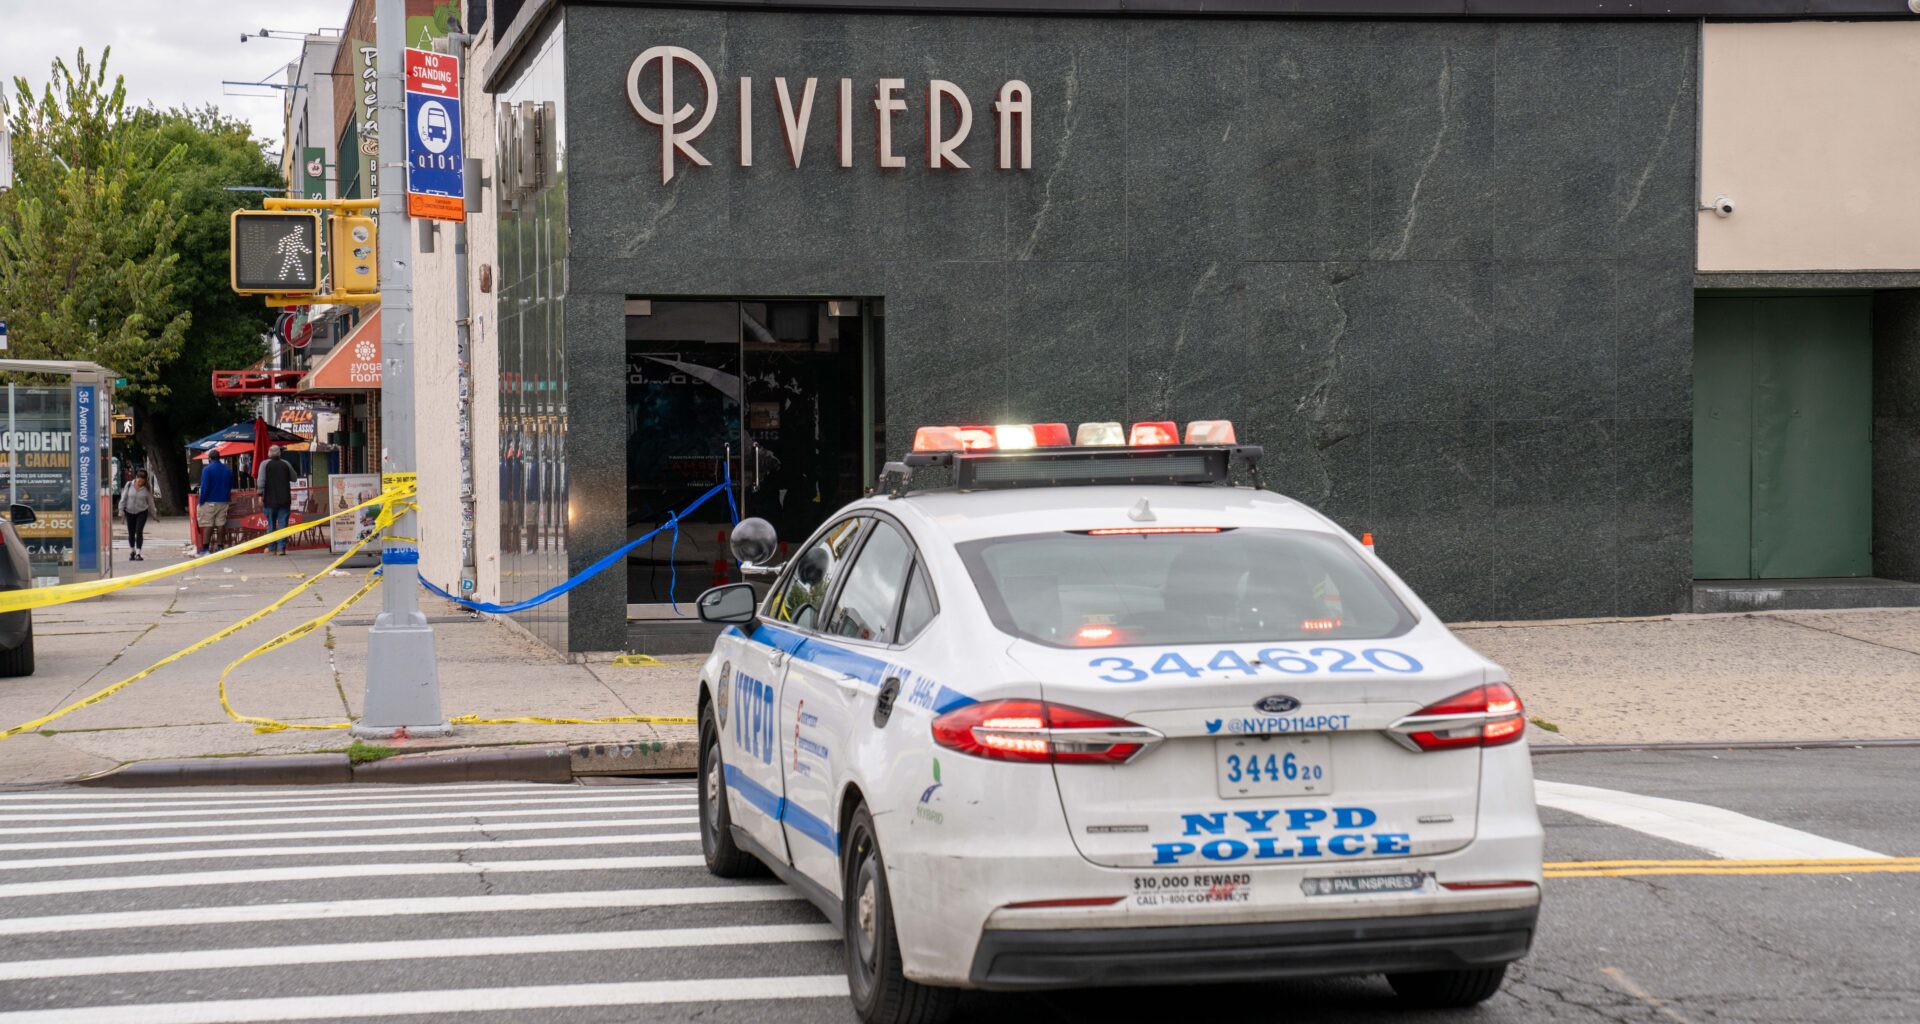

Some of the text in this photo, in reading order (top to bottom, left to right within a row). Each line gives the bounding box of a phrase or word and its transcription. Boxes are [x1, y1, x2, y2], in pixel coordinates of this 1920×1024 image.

[425, 55, 438, 68] NO
[413, 66, 452, 83] STANDING
[359, 47, 379, 132] Panera
[626, 46, 1032, 185] RIVIERA
[418, 153, 455, 170] Q101
[351, 373, 382, 382] room
[356, 363, 382, 374] yoga
[78, 391, 91, 515] 35 Avenue & Steinway St
[1088, 647, 1424, 684] 344620
[735, 670, 774, 765] NYPD
[1228, 714, 1350, 733] @NYPD114PCT
[1181, 806, 1377, 836] NYPD
[1151, 833, 1412, 865] POLICE
[1134, 874, 1250, 890] $10,000 REWARD
[1335, 876, 1412, 890] PAL INSPIRES
[1137, 896, 1158, 905] CALL
